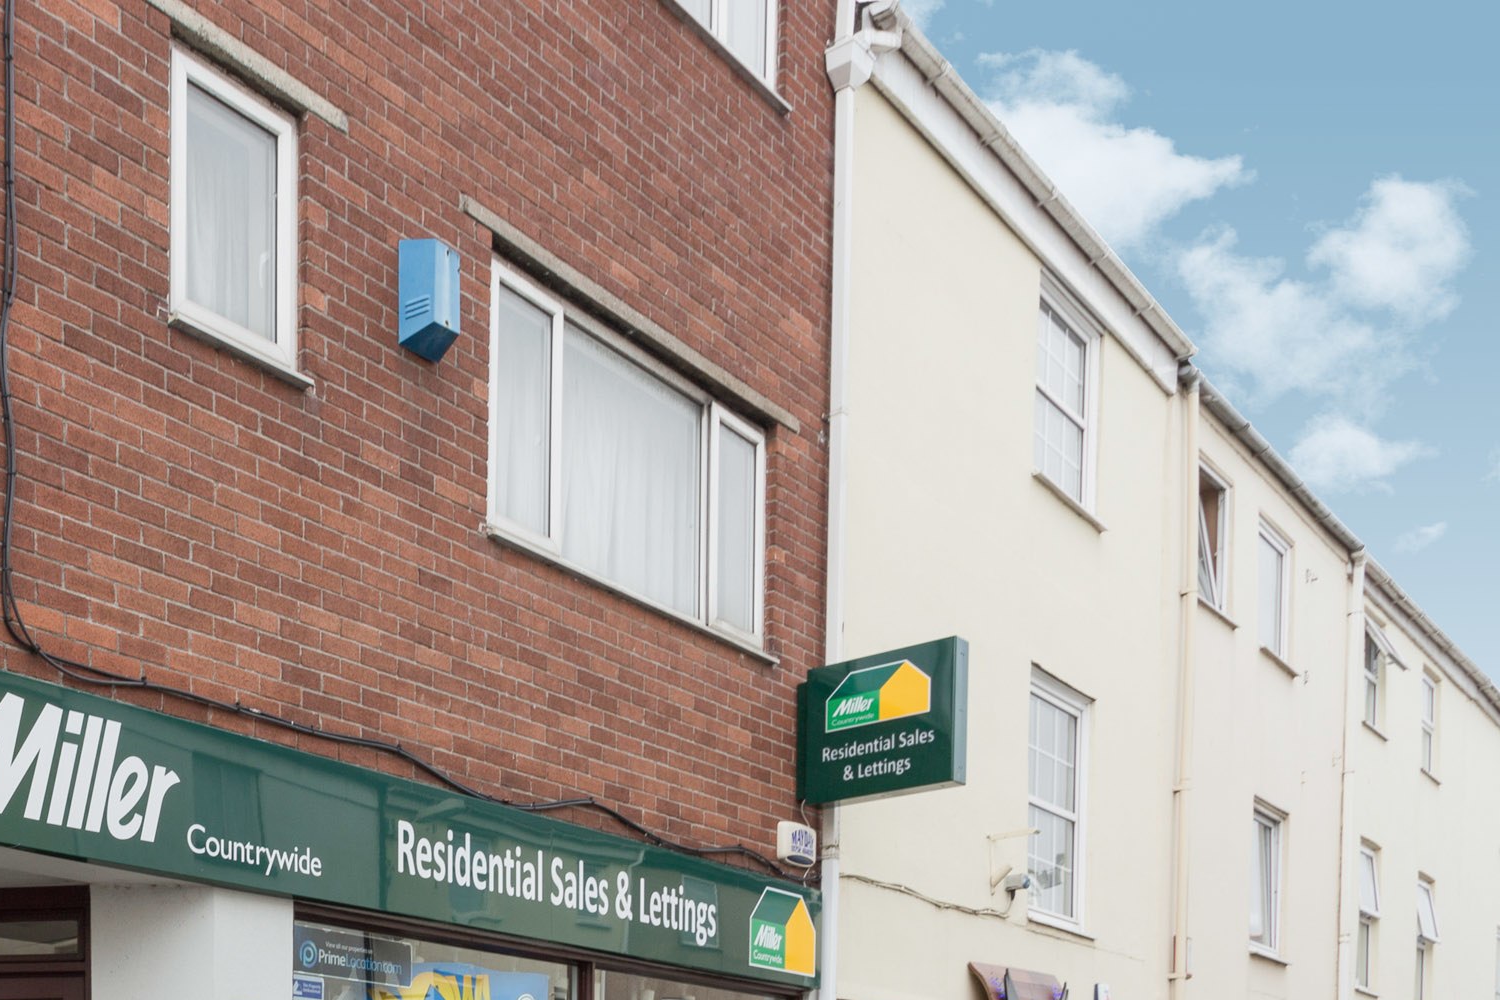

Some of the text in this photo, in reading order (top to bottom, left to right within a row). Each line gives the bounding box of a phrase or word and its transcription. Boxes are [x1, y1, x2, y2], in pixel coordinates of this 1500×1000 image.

[833, 696, 874, 718] Miller
[831, 713, 874, 726] Countrywide
[822, 729, 935, 762] Residential Sales
[843, 758, 911, 781] & Lettings
[188, 822, 322, 878] Countrywide
[792, 828, 814, 848] MAYDAY
[398, 819, 717, 947] Residential Sales & Lettings
[753, 924, 784, 952] Miller
[319, 949, 402, 974] PrimeLocation.com
[753, 950, 784, 964] Countrywide
